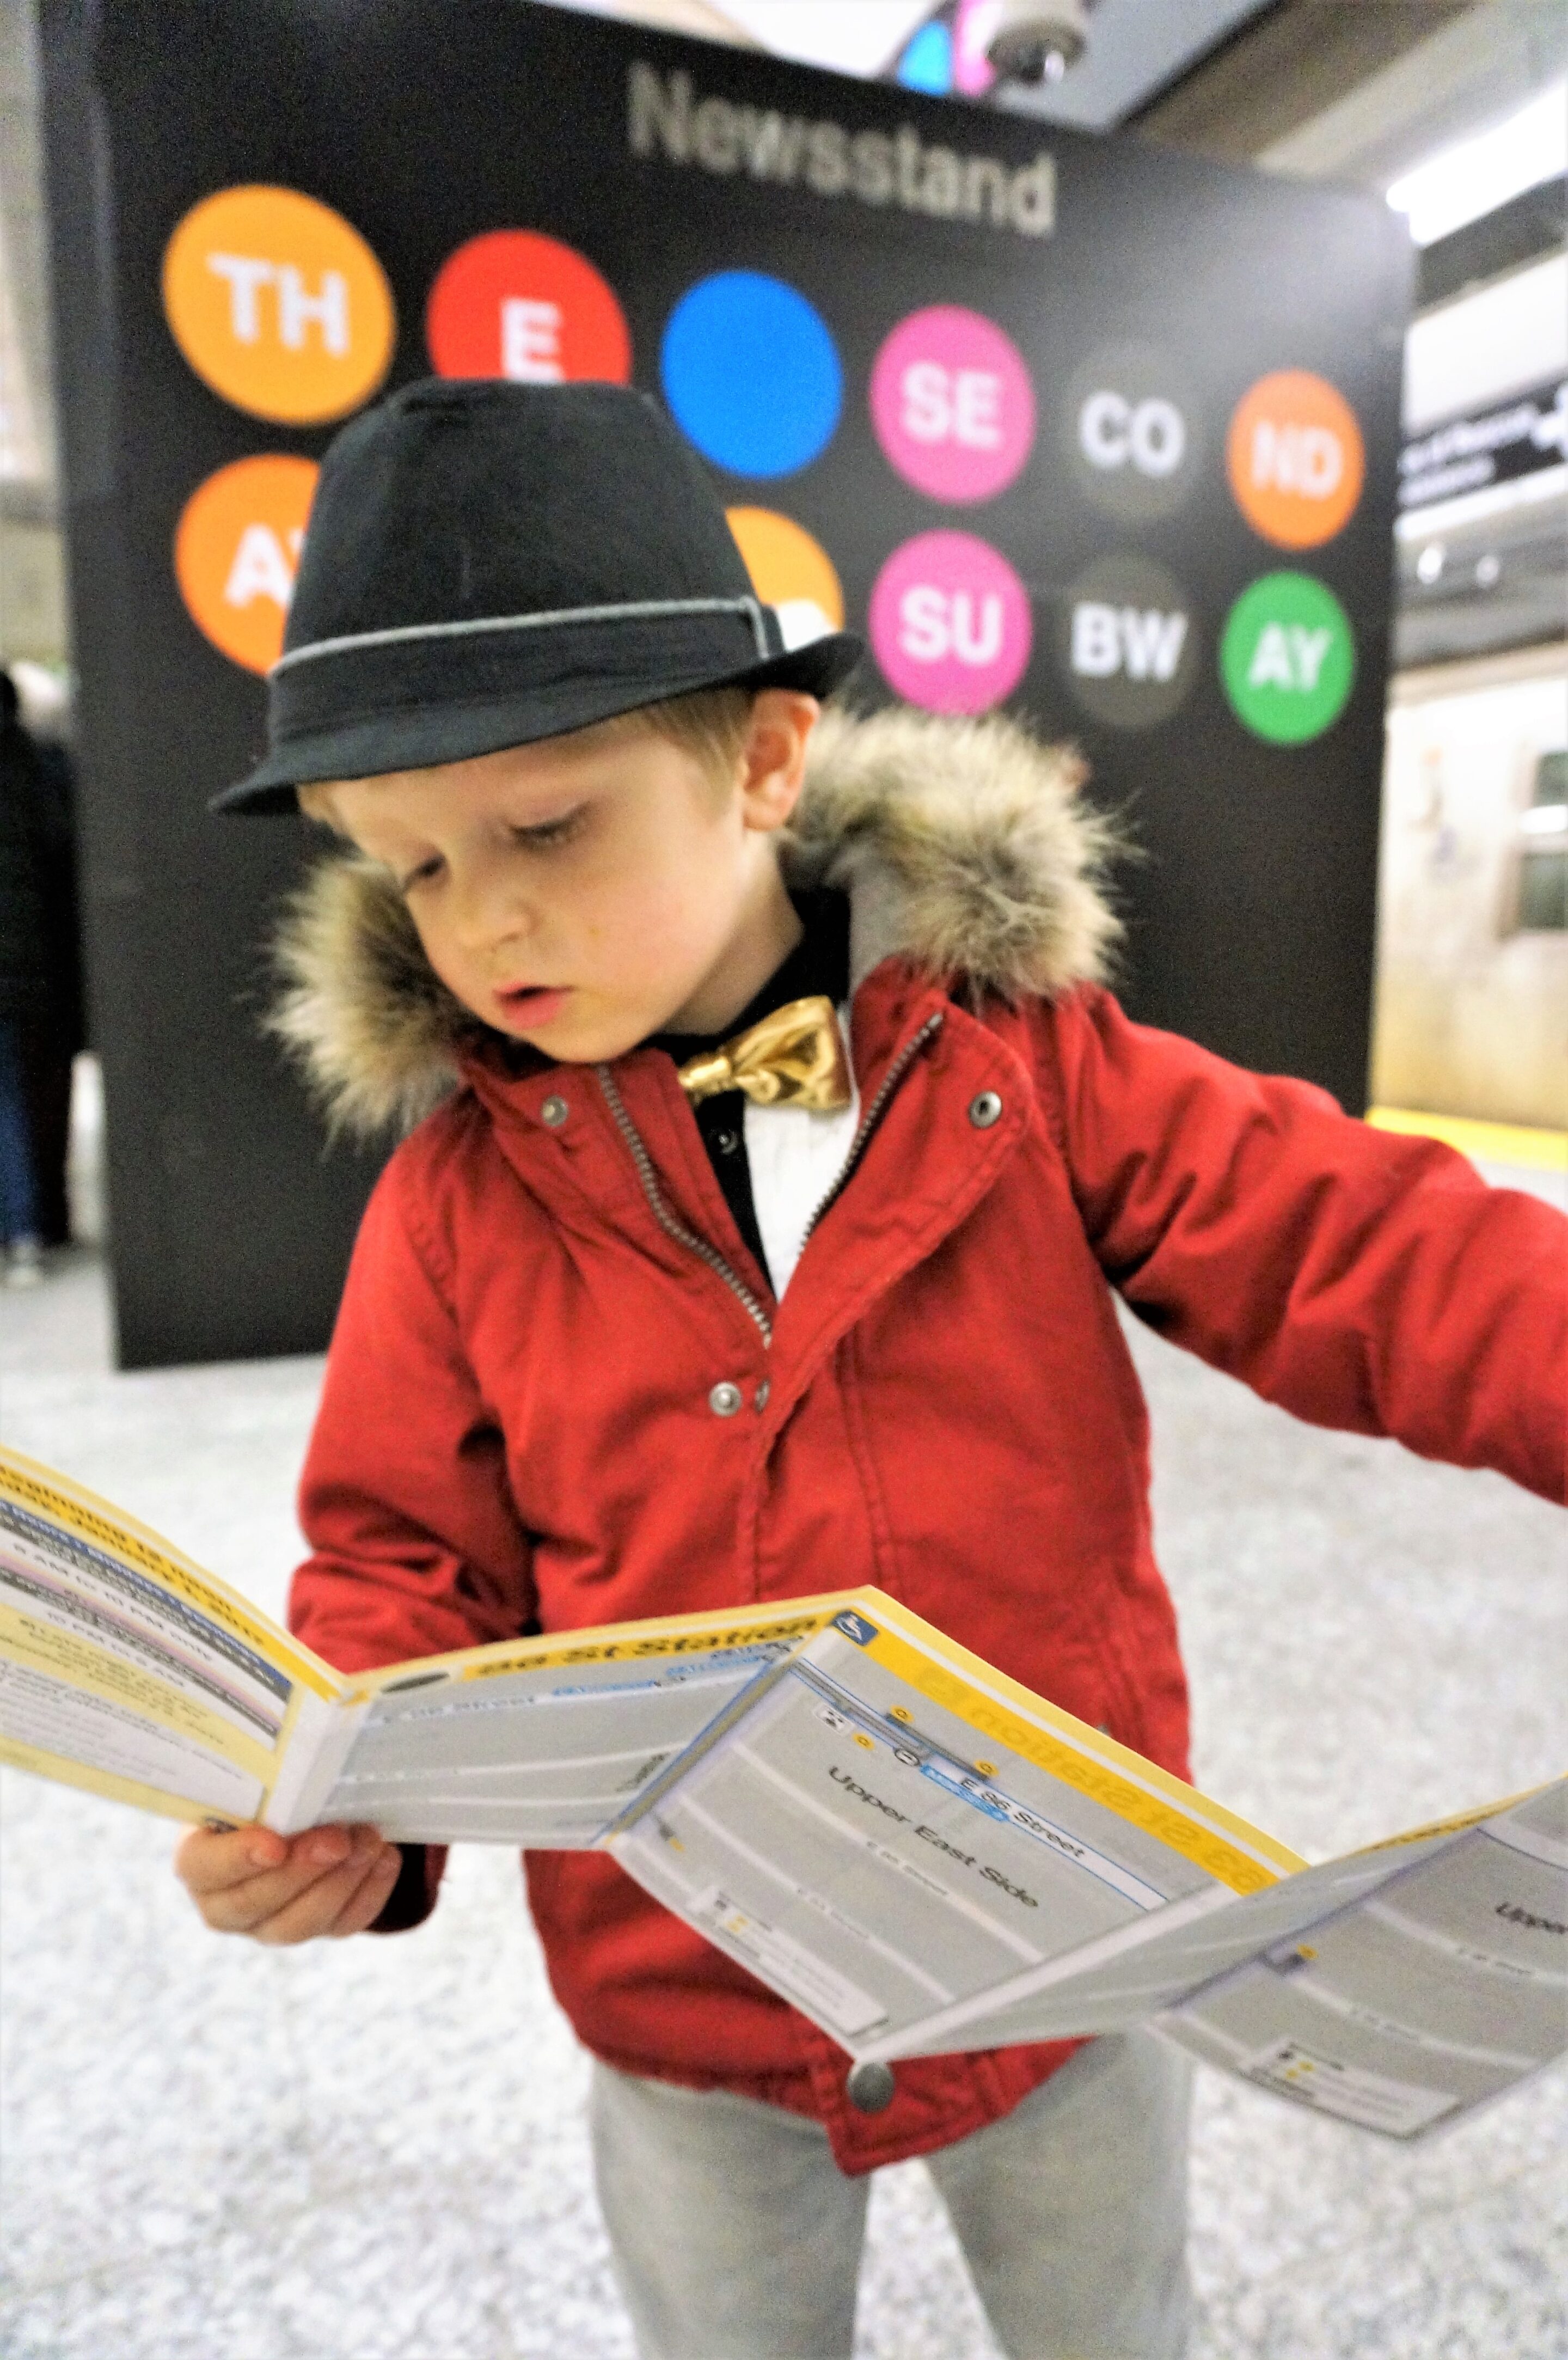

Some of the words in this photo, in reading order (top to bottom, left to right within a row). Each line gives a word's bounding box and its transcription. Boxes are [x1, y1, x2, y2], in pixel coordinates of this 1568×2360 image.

[628, 61, 1057, 237] Newsstand
[206, 252, 352, 360] TH
[499, 296, 566, 383] E
[901, 360, 1002, 449] SE
[1079, 390, 1186, 479] CO
[1250, 421, 1344, 499] ND
[899, 586, 1004, 665] SU
[1071, 600, 1188, 680] BW
[1246, 621, 1334, 691] AY
[828, 1765, 913, 1823] Upper
[914, 1824, 977, 1867] East
[979, 1866, 1039, 1907] Side
[960, 1777, 978, 1792] E
[981, 1790, 1011, 1811] 86
[1013, 1811, 1085, 1858] Street
